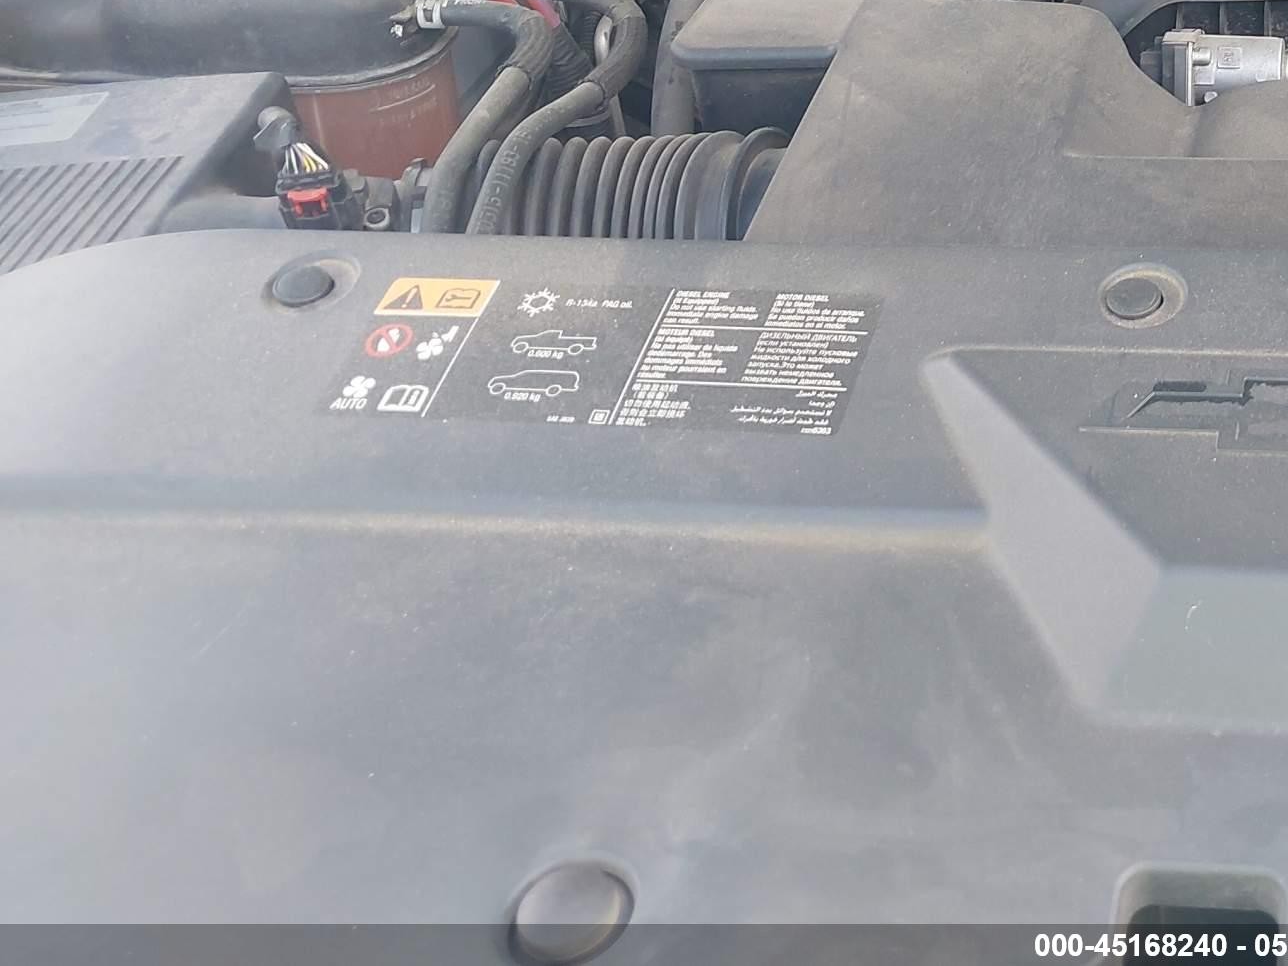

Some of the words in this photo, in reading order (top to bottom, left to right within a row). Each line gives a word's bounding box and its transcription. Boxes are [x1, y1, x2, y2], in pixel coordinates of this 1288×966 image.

[775, 293, 804, 301] MOTOR
[601, 300, 620, 308] PAG
[329, 396, 368, 410] AUTO
